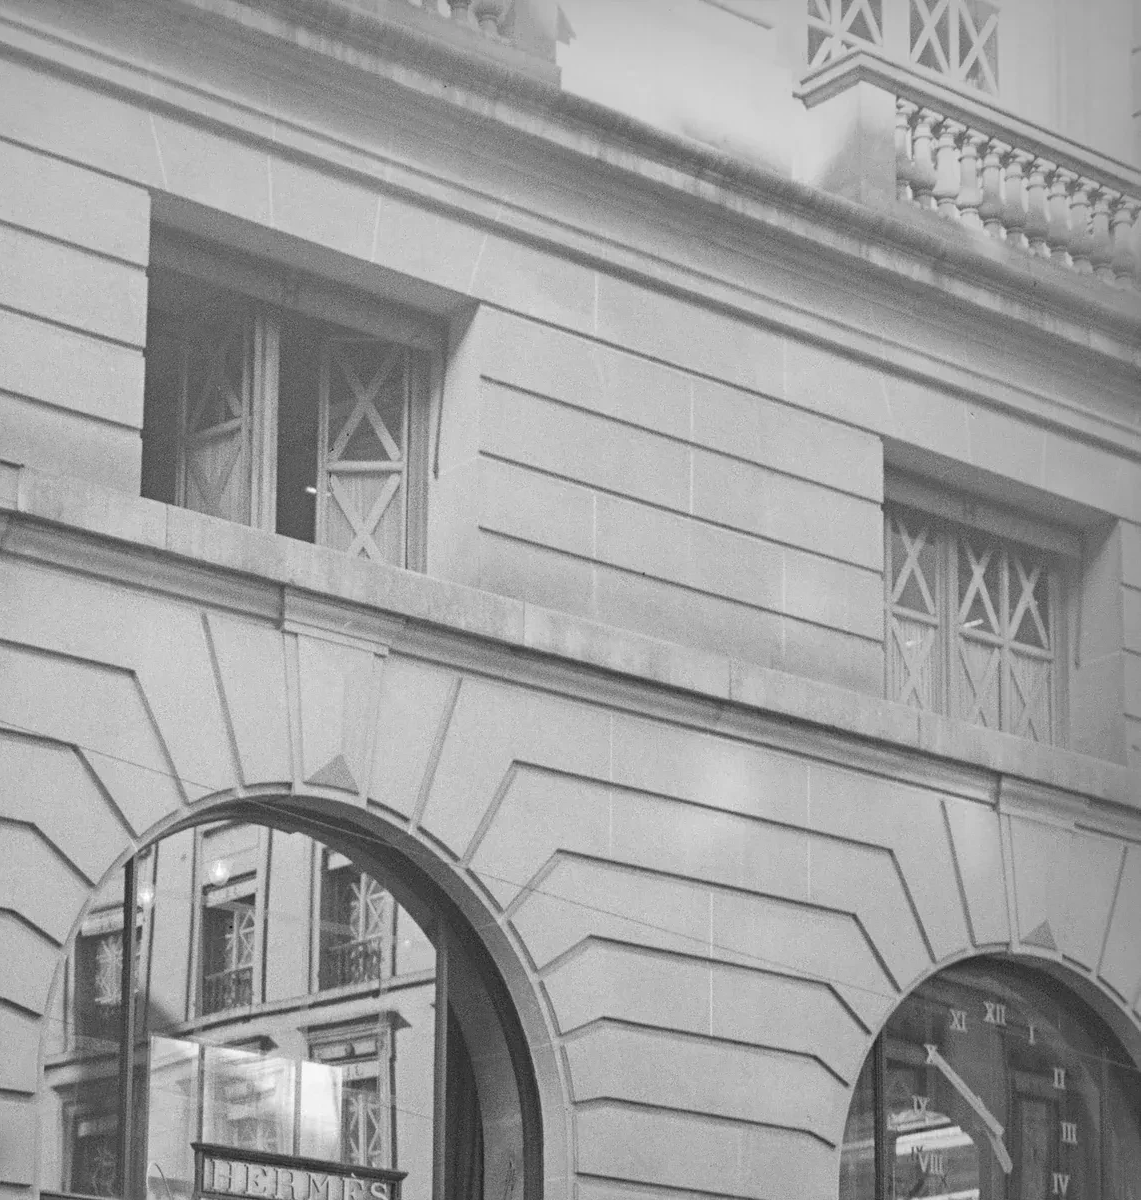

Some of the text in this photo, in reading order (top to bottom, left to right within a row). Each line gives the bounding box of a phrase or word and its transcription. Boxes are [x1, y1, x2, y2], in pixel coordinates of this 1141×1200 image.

[949, 1008, 967, 1033] XI
[983, 1000, 1006, 1026] XII
[1053, 1066, 1065, 1090] II
[1061, 1121, 1077, 1145] III
[918, 1152, 945, 1176] VIII
[1052, 1172, 1071, 1196] IV
